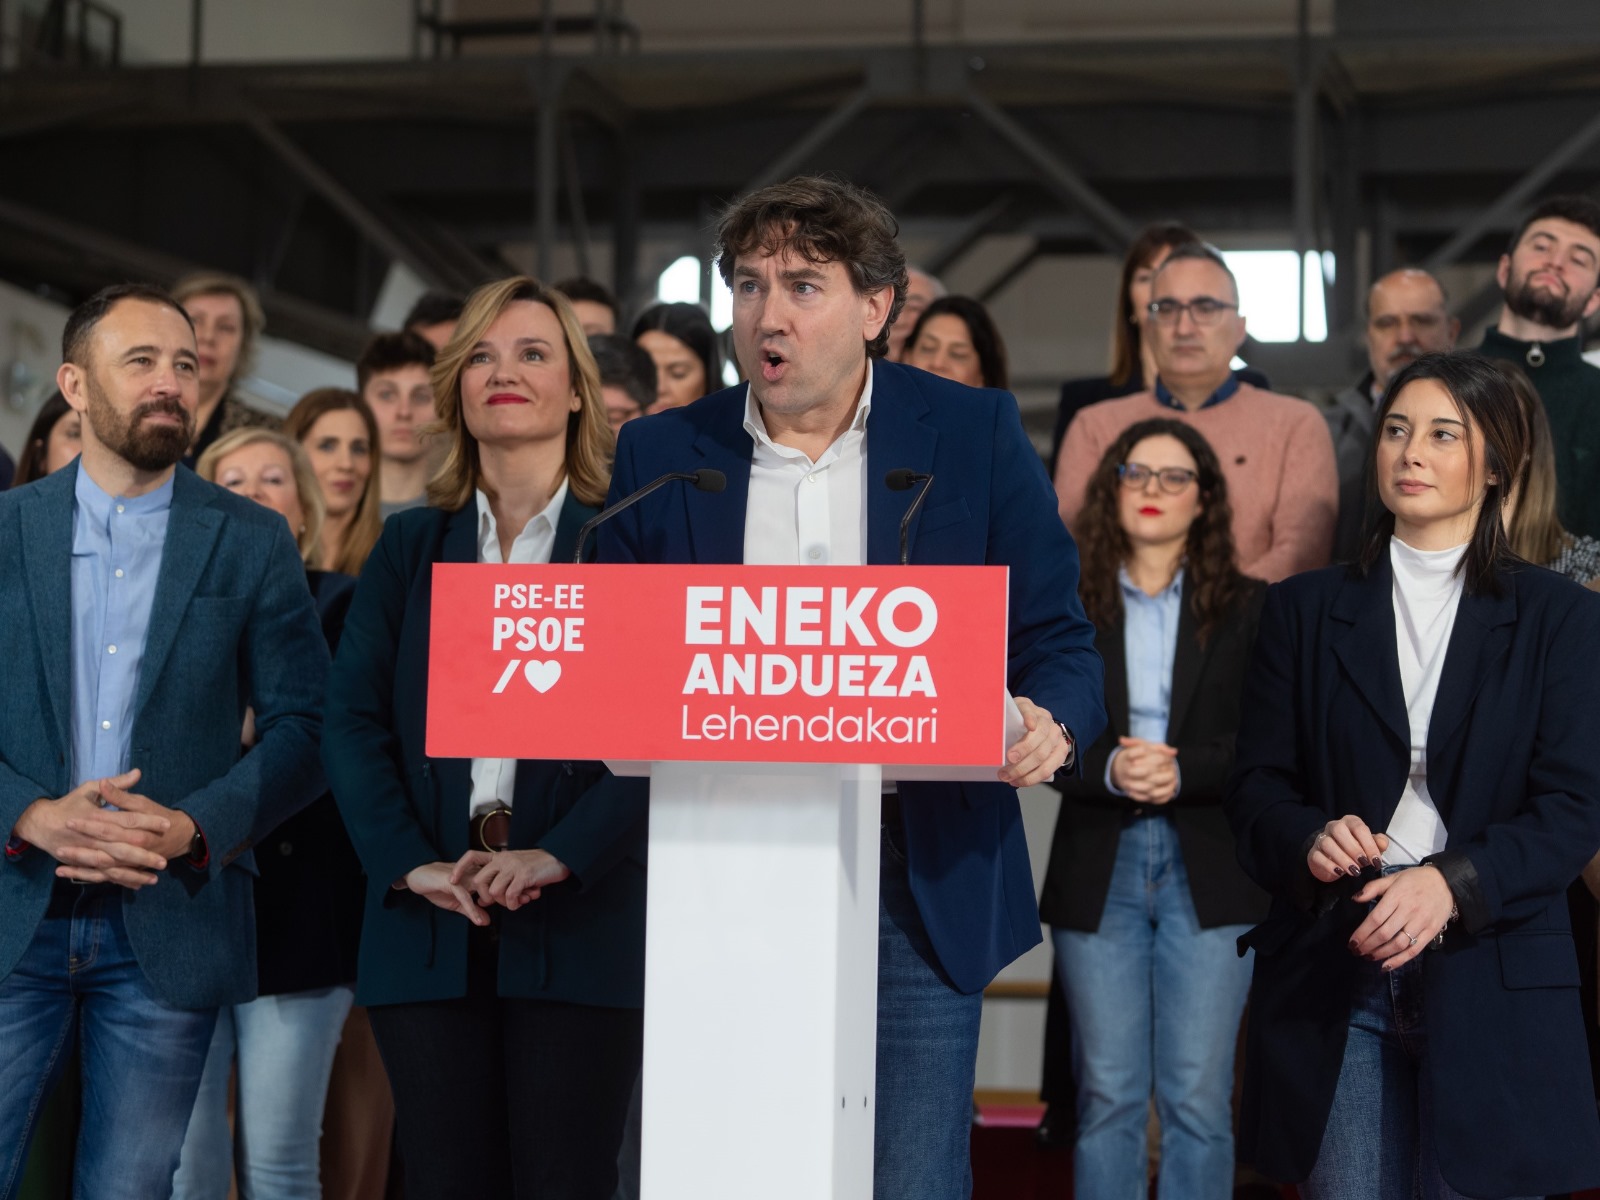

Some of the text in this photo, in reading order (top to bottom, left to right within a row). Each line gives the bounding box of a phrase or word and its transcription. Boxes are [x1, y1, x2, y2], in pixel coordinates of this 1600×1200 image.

[493, 583, 585, 610] PSE-EE
[684, 585, 939, 648] ENEKO
[492, 616, 585, 652] PSOE
[682, 653, 938, 698] ANDUEZA
[681, 704, 938, 744] Lehendakari
